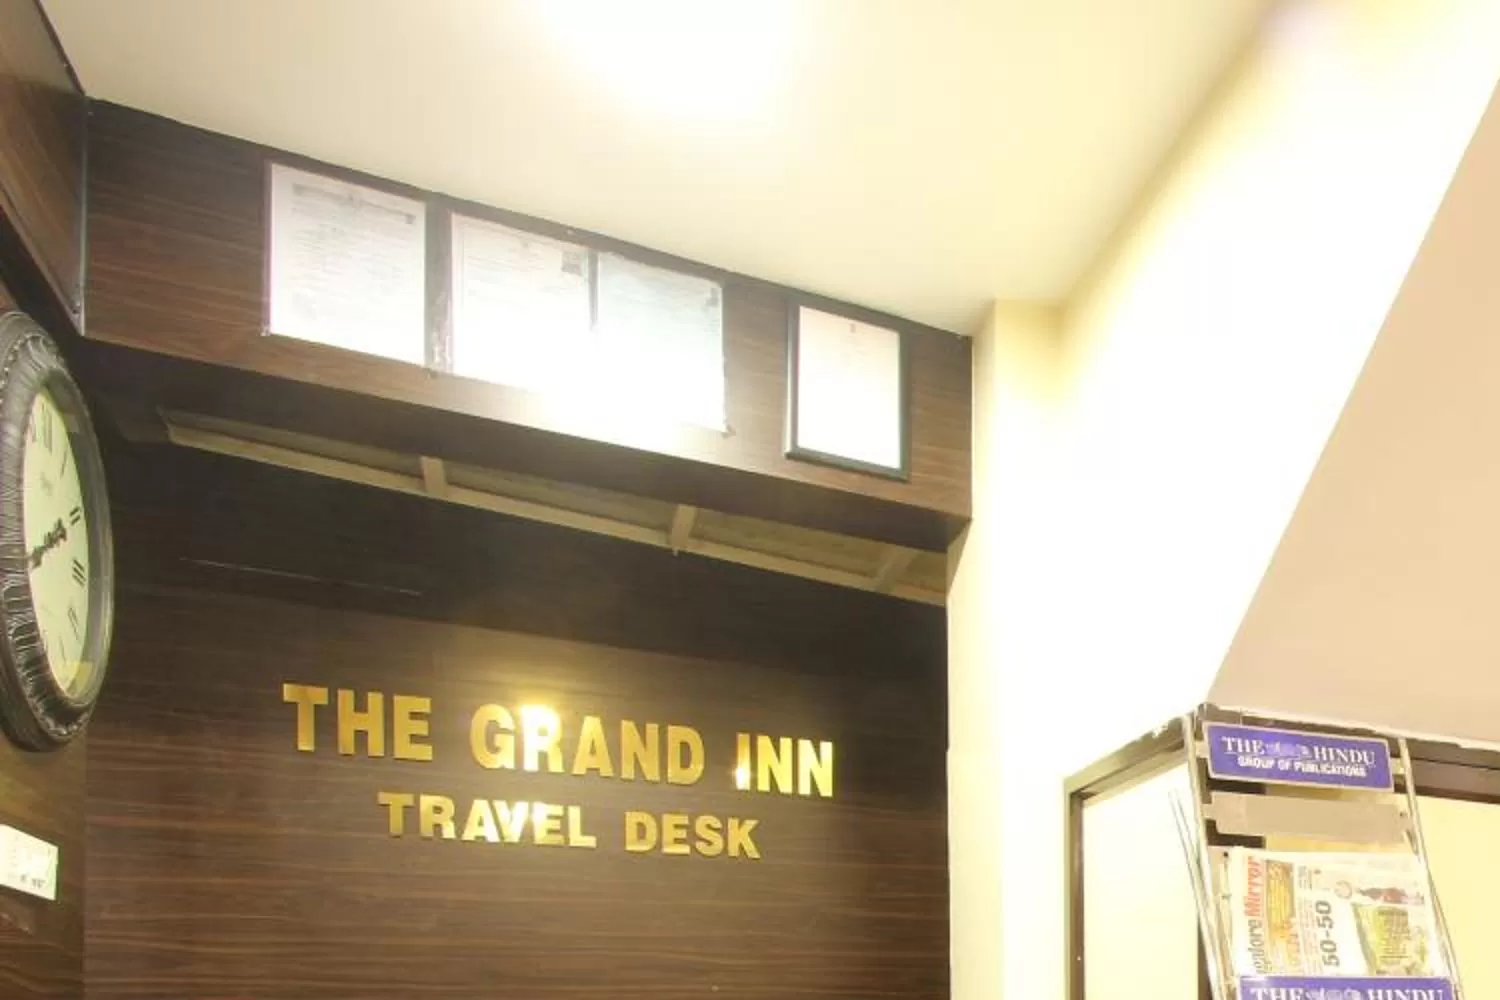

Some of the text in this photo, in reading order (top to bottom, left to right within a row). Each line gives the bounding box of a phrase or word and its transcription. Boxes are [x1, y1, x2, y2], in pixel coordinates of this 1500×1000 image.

[282, 683, 834, 797] THE GRAND INN
[1222, 736, 1376, 766] THE HINDU
[1237, 755, 1367, 777] GROUP OF PUBLICATIONS
[377, 792, 761, 859] TRAVEL DESK
[1243, 855, 1262, 917] Mirror
[1315, 900, 1340, 967] 50-50
